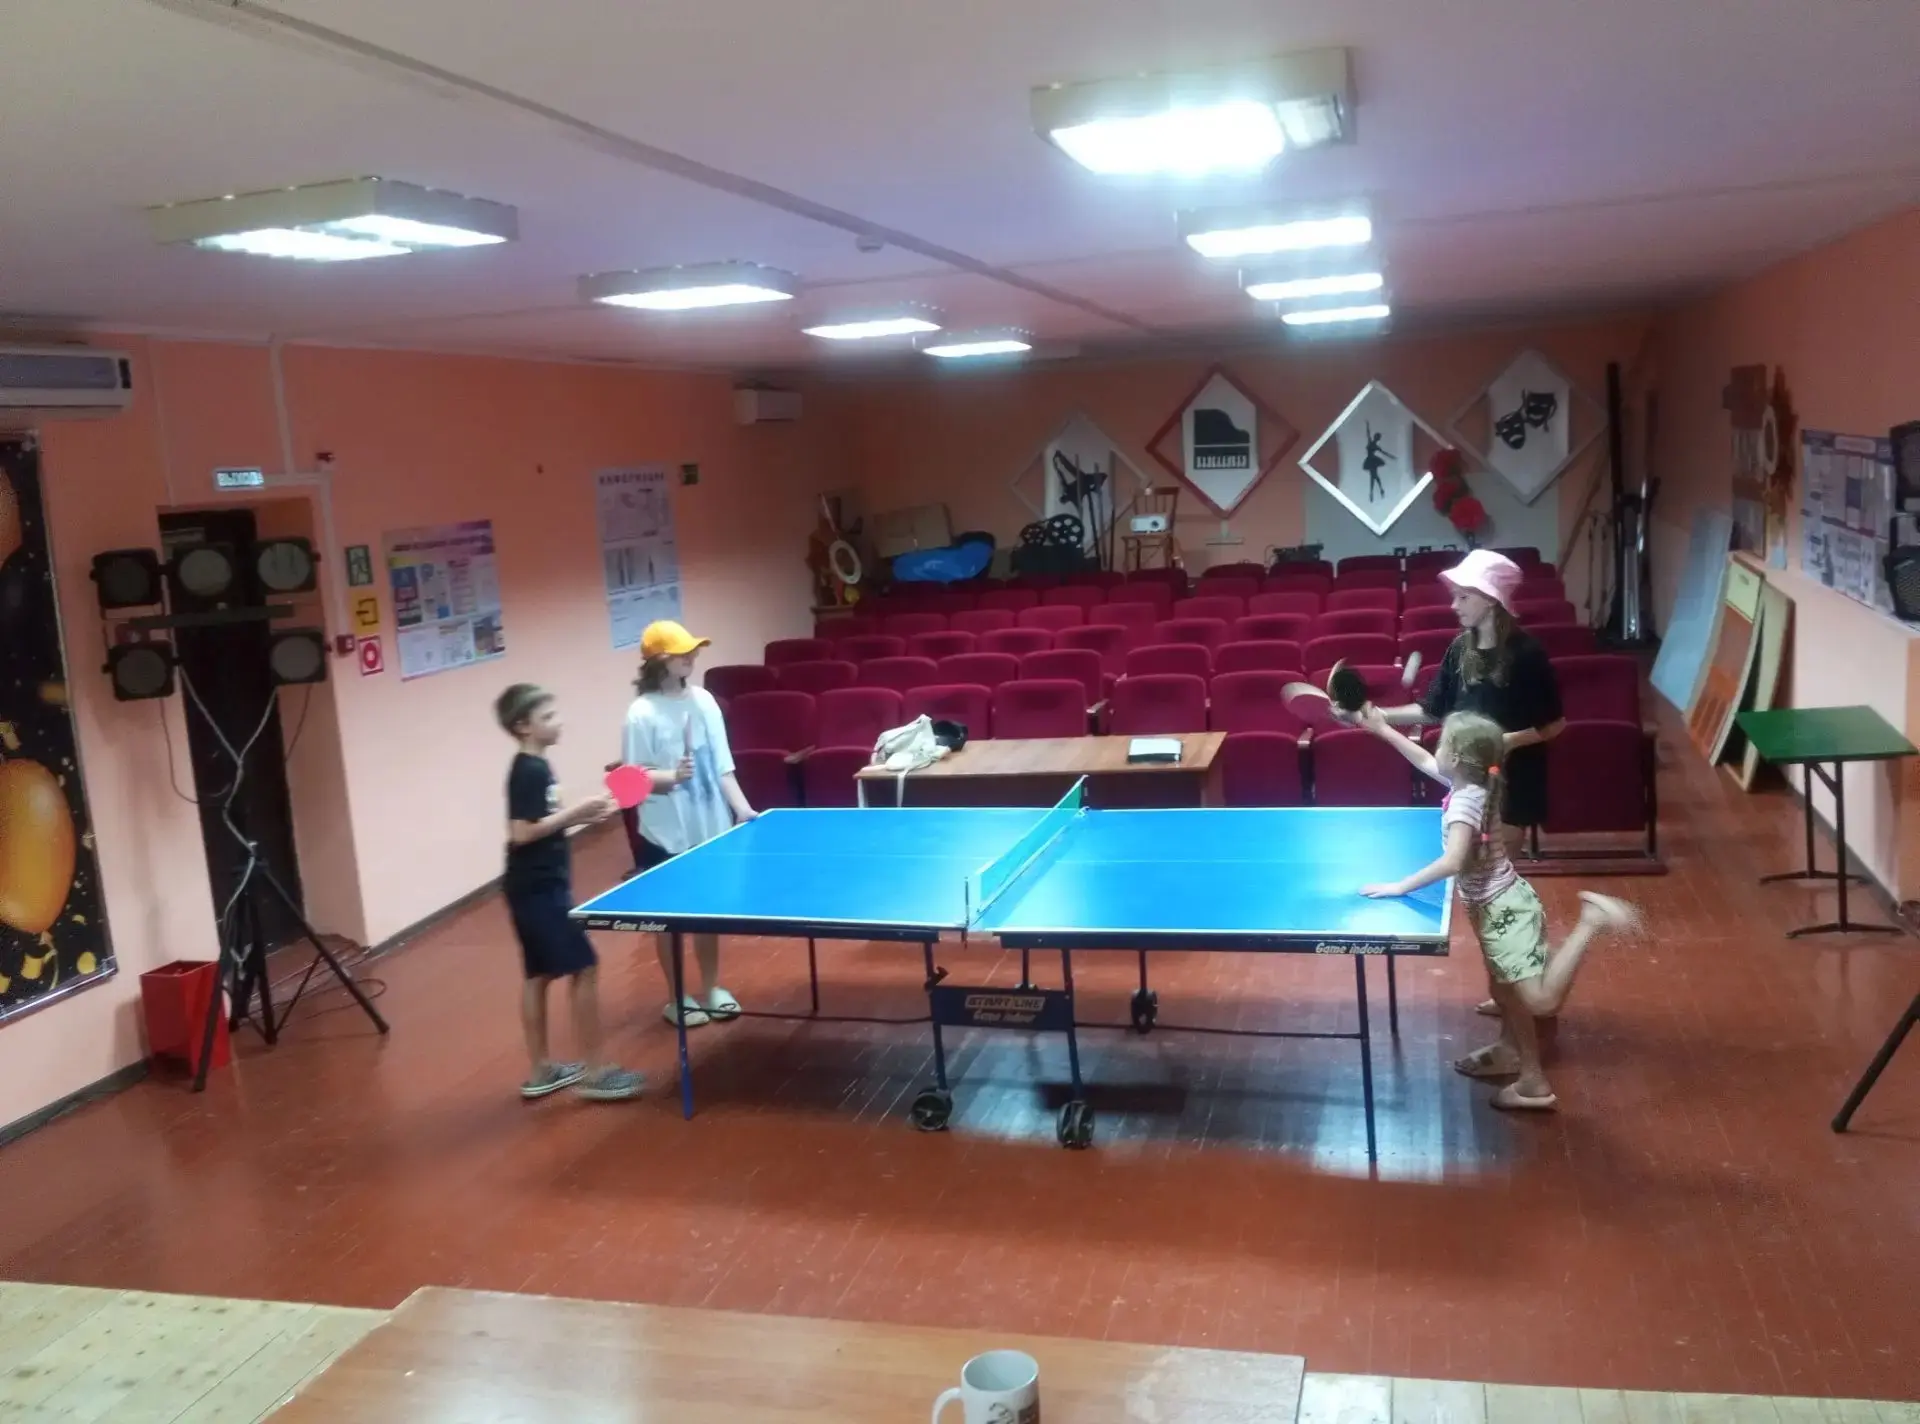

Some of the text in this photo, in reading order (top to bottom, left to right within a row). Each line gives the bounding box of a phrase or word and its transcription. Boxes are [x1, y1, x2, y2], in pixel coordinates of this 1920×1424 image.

[613, 920, 638, 931] Game
[639, 921, 667, 931] indoor
[1315, 943, 1347, 954] Game
[1349, 943, 1386, 954] indoor
[969, 997, 1041, 1009] START LINE
